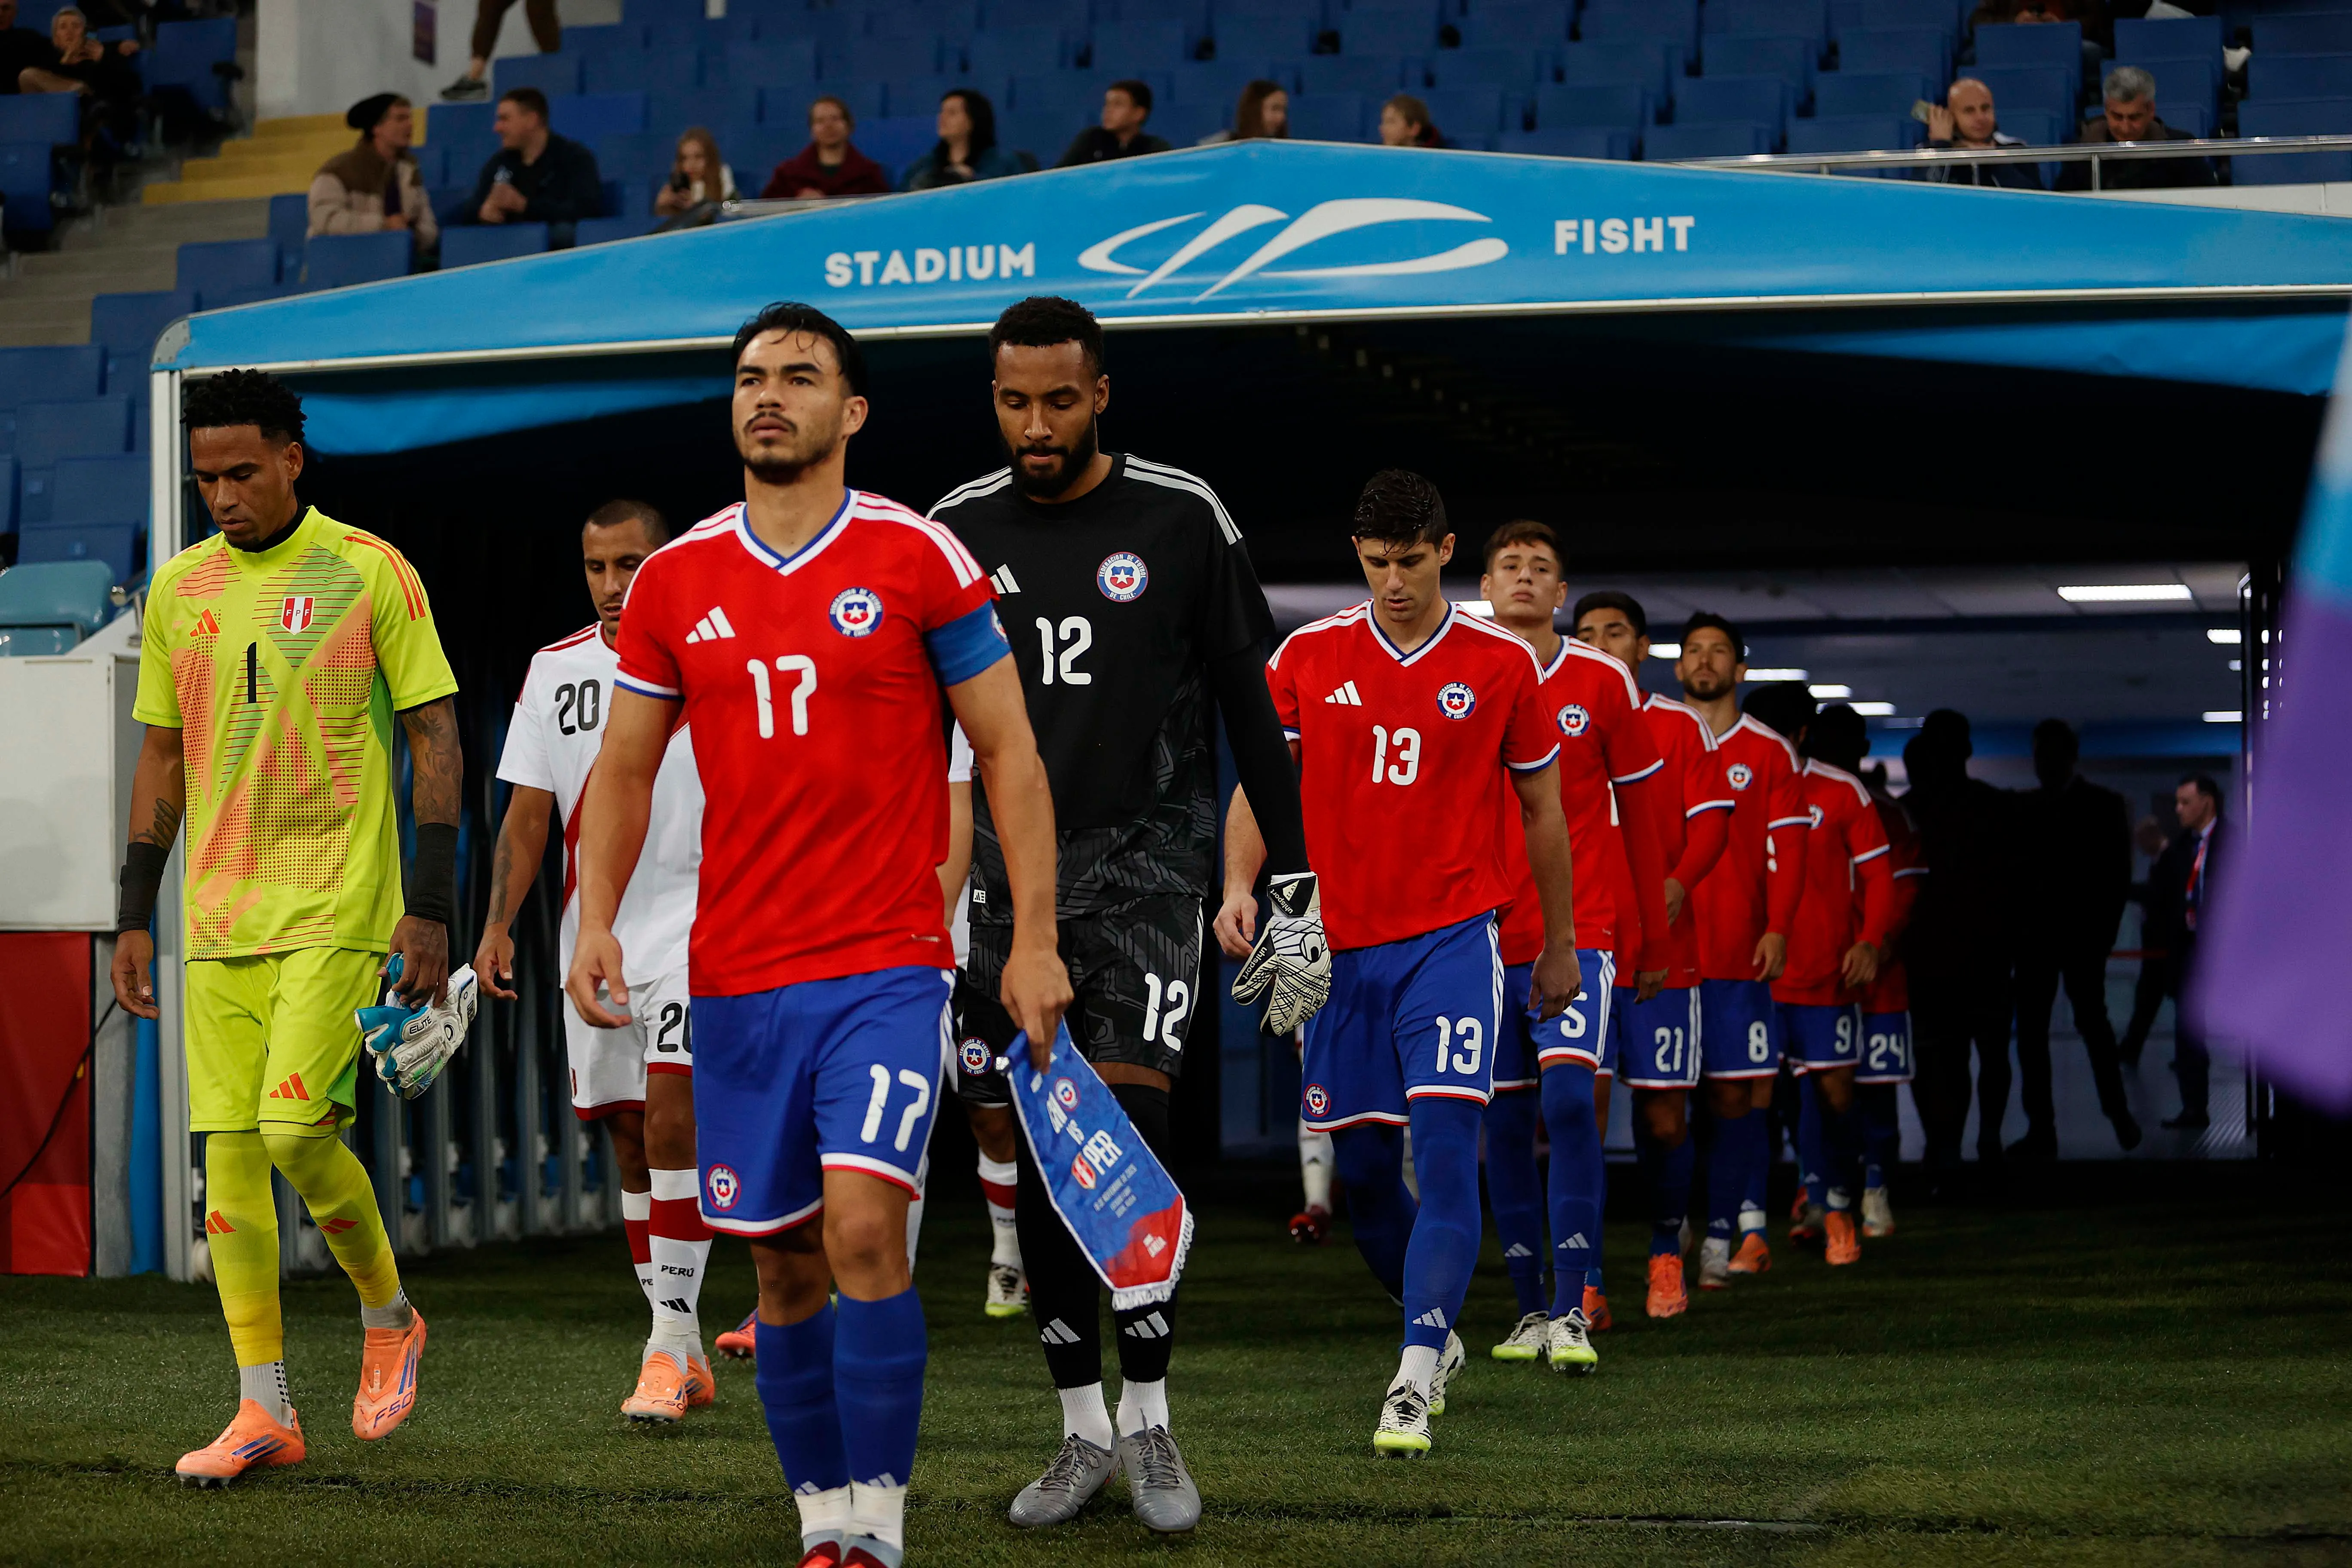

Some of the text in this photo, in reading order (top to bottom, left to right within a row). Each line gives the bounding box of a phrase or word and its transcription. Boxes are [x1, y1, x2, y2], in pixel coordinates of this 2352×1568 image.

[1555, 215, 1697, 255] FISHT
[825, 242, 1037, 289] STADIUM
[1099, 554, 1124, 577] FEDERACION
[1134, 560, 1147, 579] FUTBOL
[1120, 592, 1135, 600] CHILE
[247, 641, 257, 704] 1
[1036, 616, 1092, 685] 12
[554, 679, 600, 735] 20
[747, 654, 817, 739] 17
[1372, 725, 1421, 786] 13
[1270, 888, 1293, 914] uhlsport
[1242, 947, 1268, 979] uhlsport
[410, 1016, 432, 1034] ELITE
[1143, 973, 1189, 1052] 12
[1560, 991, 1588, 1038] 5
[1835, 1015, 1852, 1054] 9
[959, 1038, 974, 1056] FEDERACION
[1436, 1016, 1482, 1074] 13
[1655, 1026, 1683, 1073] 21
[1749, 1021, 1769, 1063] 8
[1869, 1034, 1906, 1072] 24
[861, 1064, 930, 1152] 17
[1082, 1130, 1123, 1176] PER
[373, 1391, 413, 1429] F50
